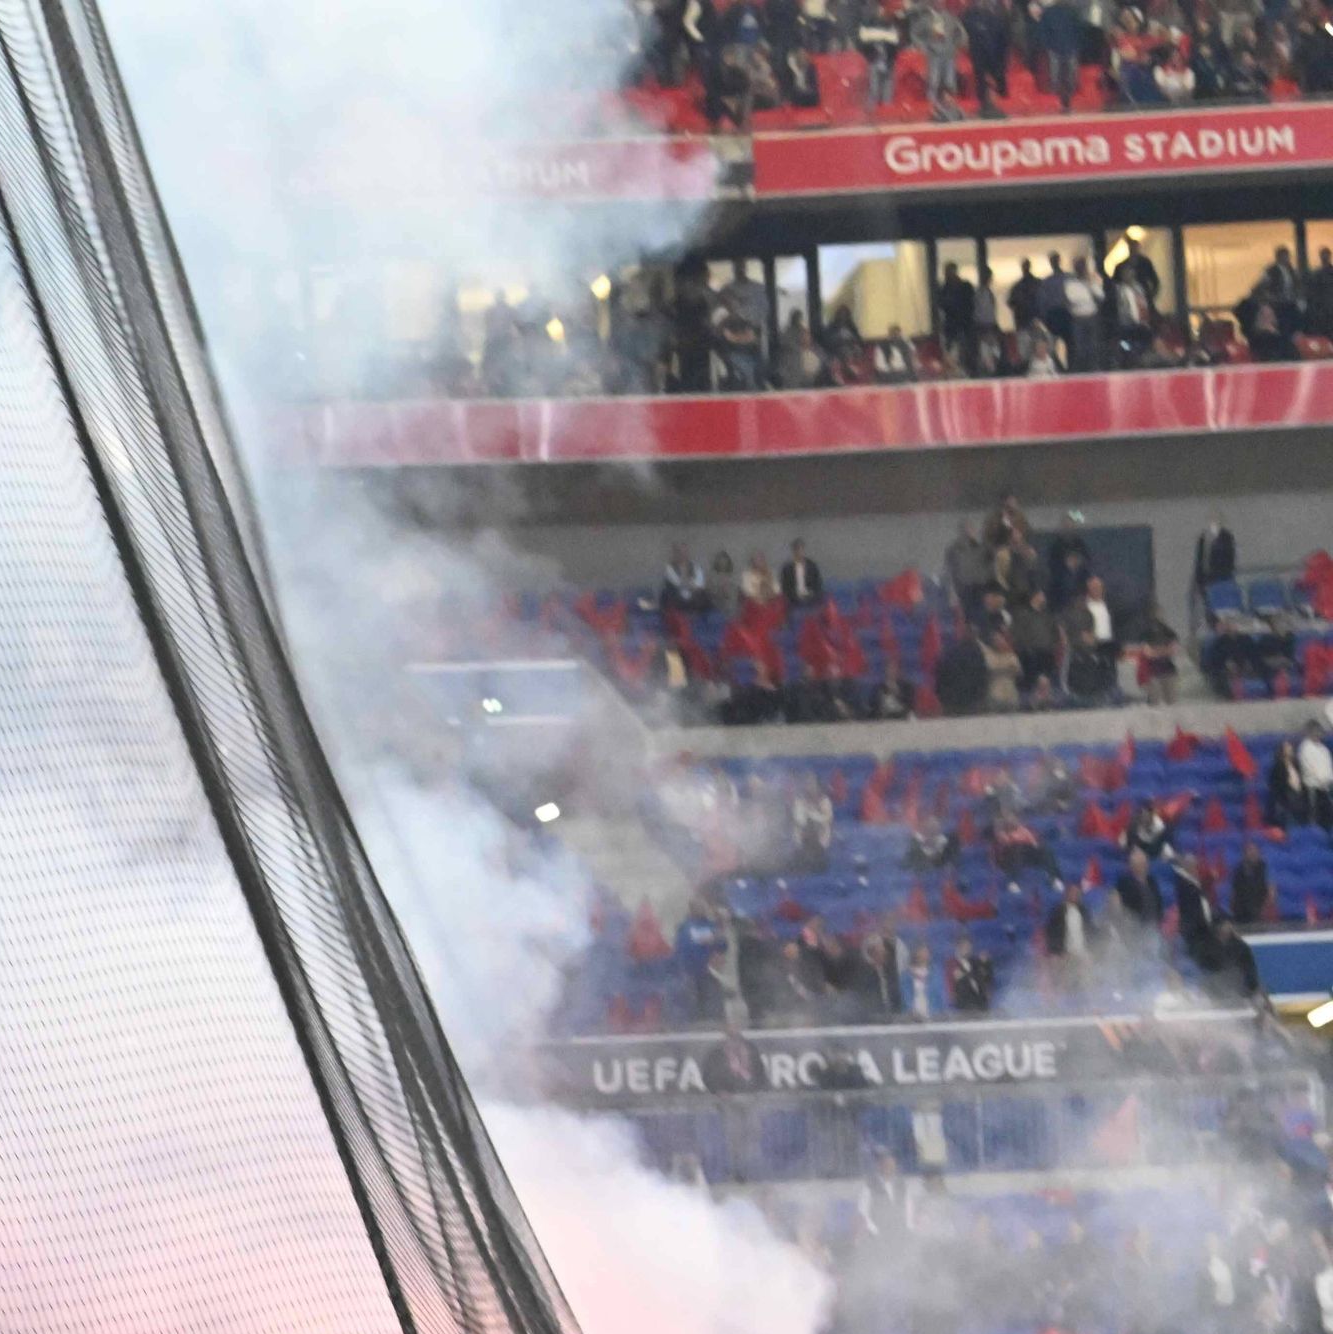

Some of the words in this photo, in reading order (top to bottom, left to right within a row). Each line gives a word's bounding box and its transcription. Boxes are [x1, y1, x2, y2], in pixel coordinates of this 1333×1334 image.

[885, 136, 1110, 175] Groupama
[1123, 126, 1295, 161] STADIUM
[593, 1056, 707, 1094] UEFA
[892, 1040, 1057, 1083] LEAGUE
